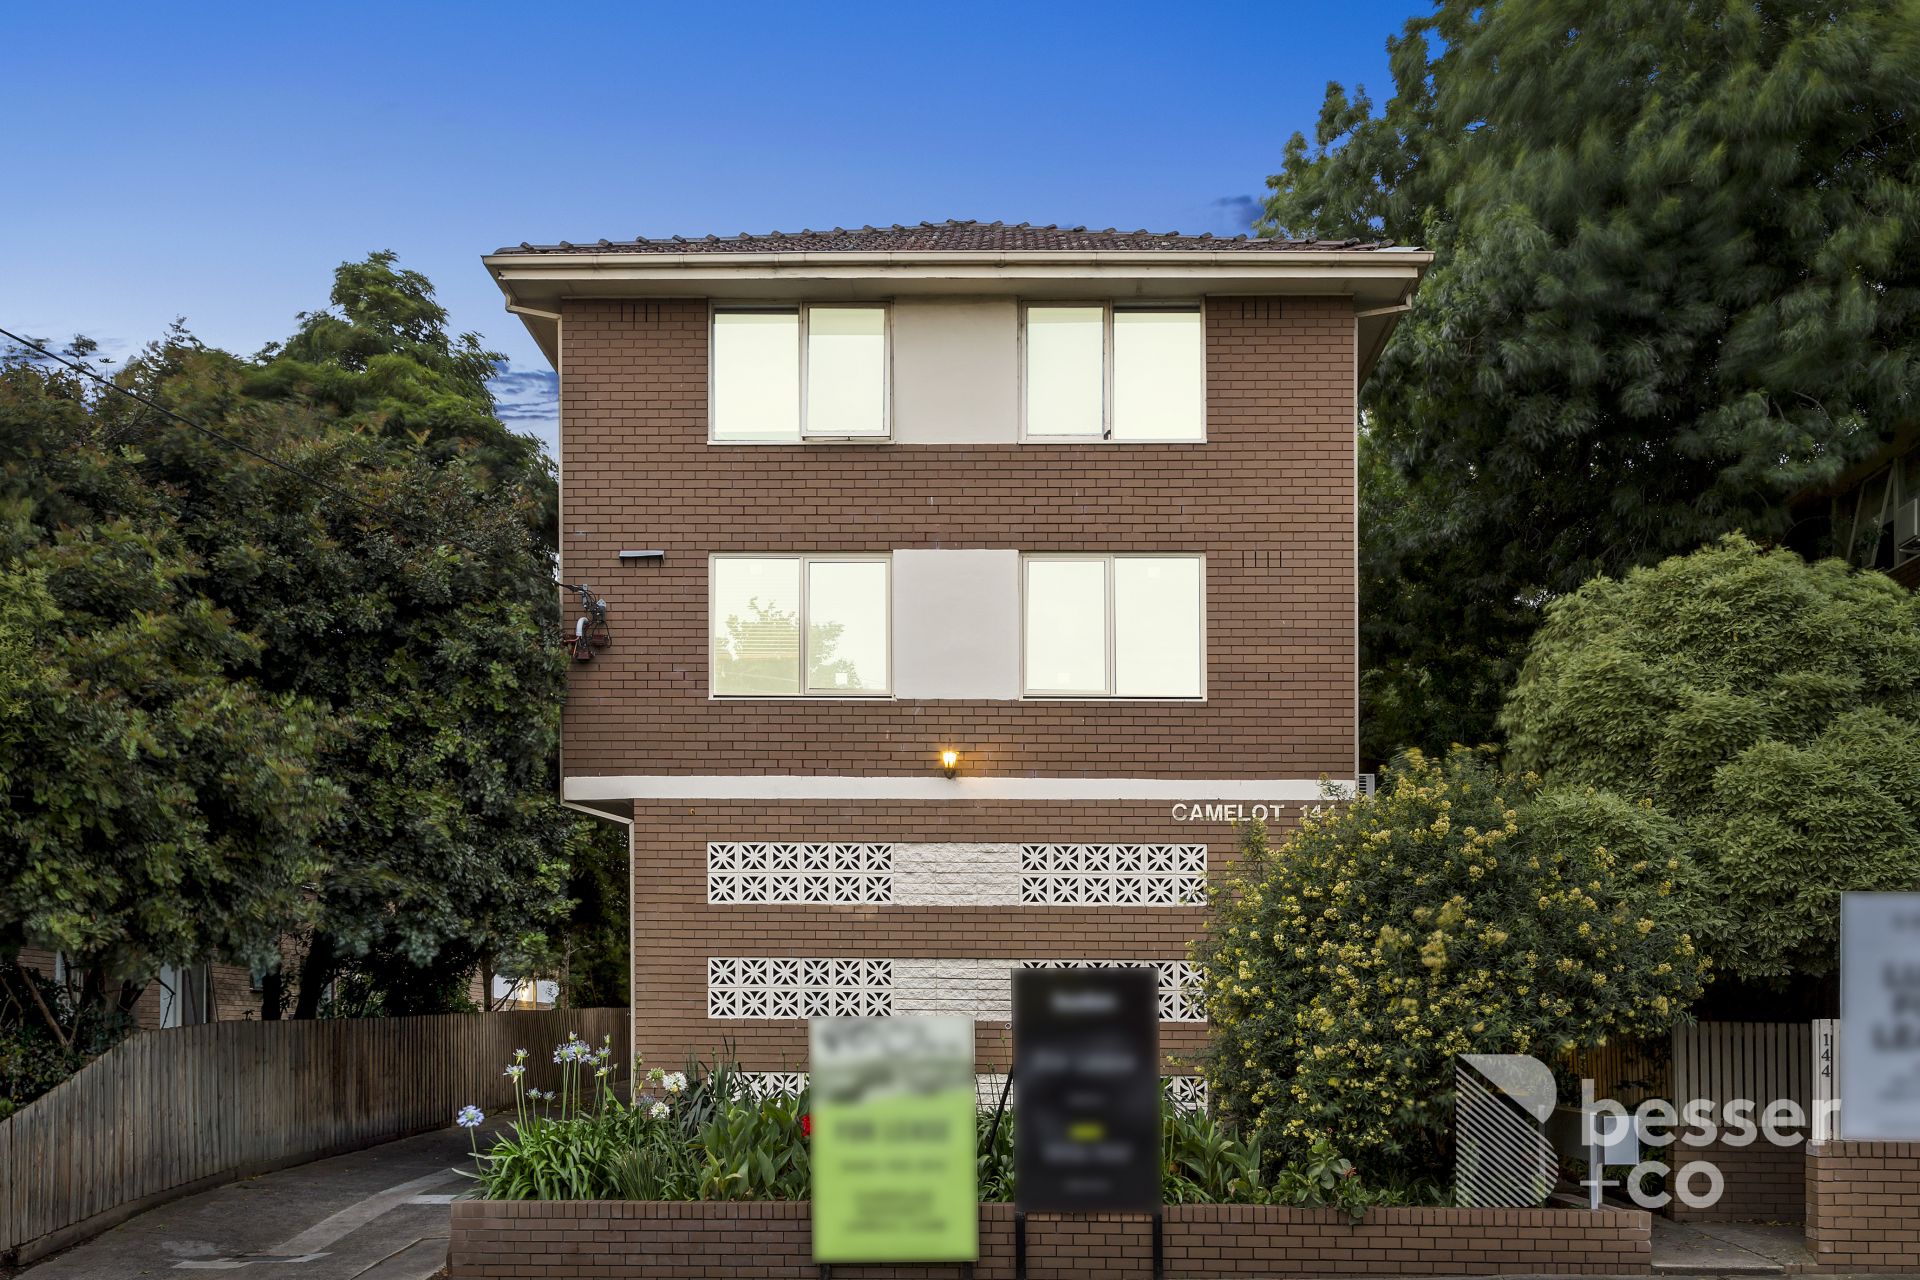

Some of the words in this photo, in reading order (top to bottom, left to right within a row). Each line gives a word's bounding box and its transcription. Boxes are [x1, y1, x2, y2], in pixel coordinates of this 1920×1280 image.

[1171, 803, 1285, 822] CAMELOT
[1299, 804, 1336, 821] 14
[1821, 1033, 1831, 1078] 144
